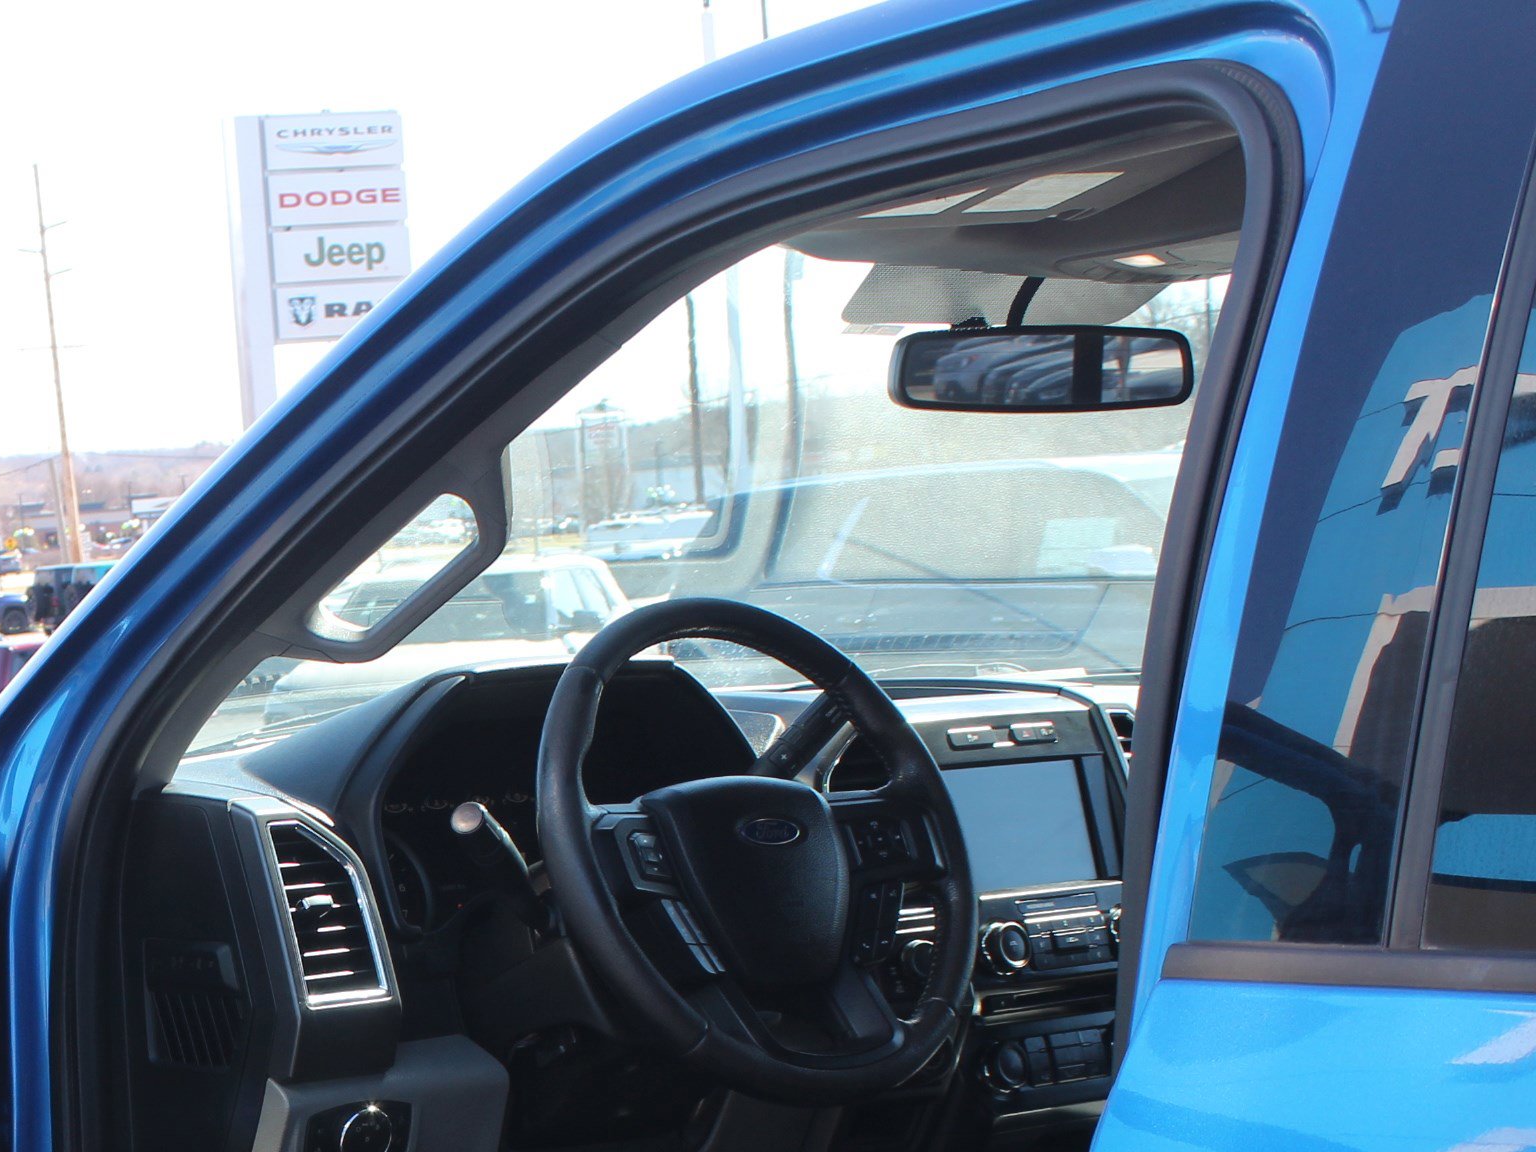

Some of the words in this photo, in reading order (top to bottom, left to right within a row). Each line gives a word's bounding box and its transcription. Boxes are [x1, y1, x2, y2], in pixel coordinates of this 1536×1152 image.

[276, 125, 393, 139] CHRYSLER
[278, 187, 401, 208] DODGE
[304, 236, 385, 270] Jeep
[324, 301, 374, 318] RA
